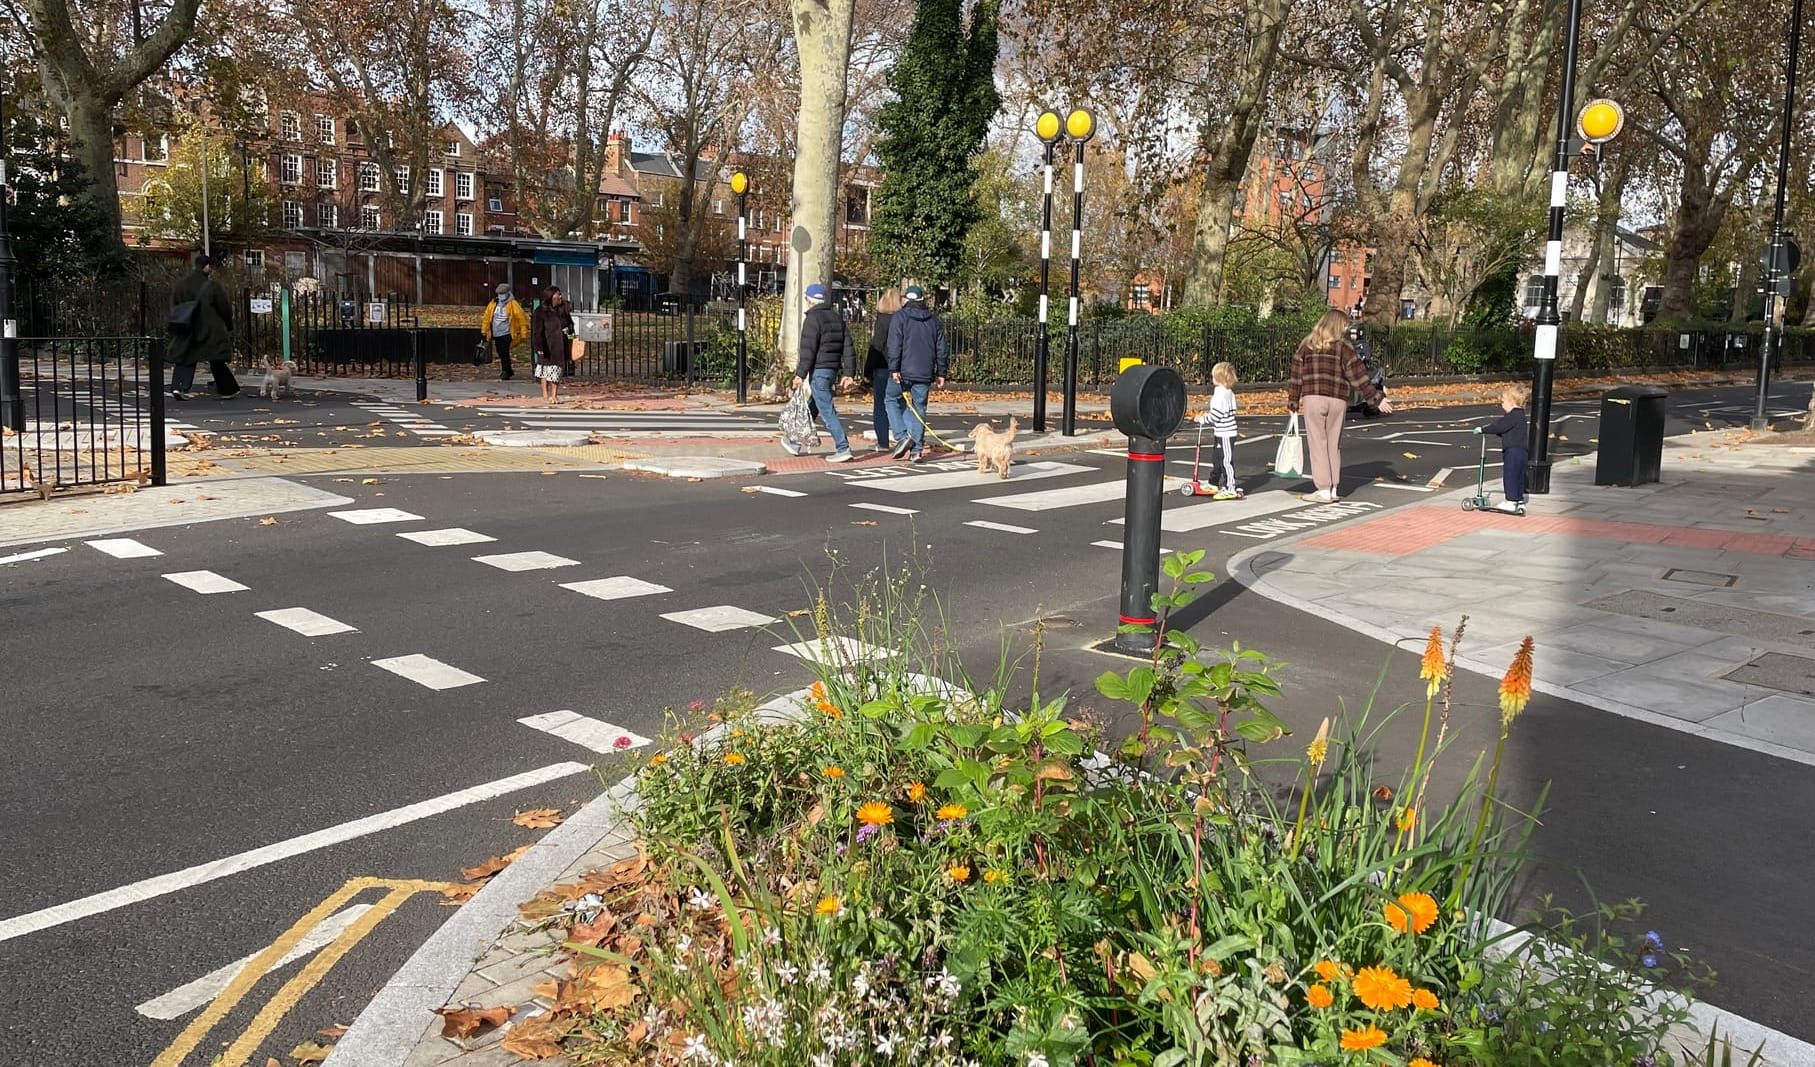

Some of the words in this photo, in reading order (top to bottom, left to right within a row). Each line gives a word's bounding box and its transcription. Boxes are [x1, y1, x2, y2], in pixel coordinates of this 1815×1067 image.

[824, 465, 928, 480] LEFT
[1218, 517, 1317, 539] LOOK
[1281, 501, 1384, 522] RIGHT
